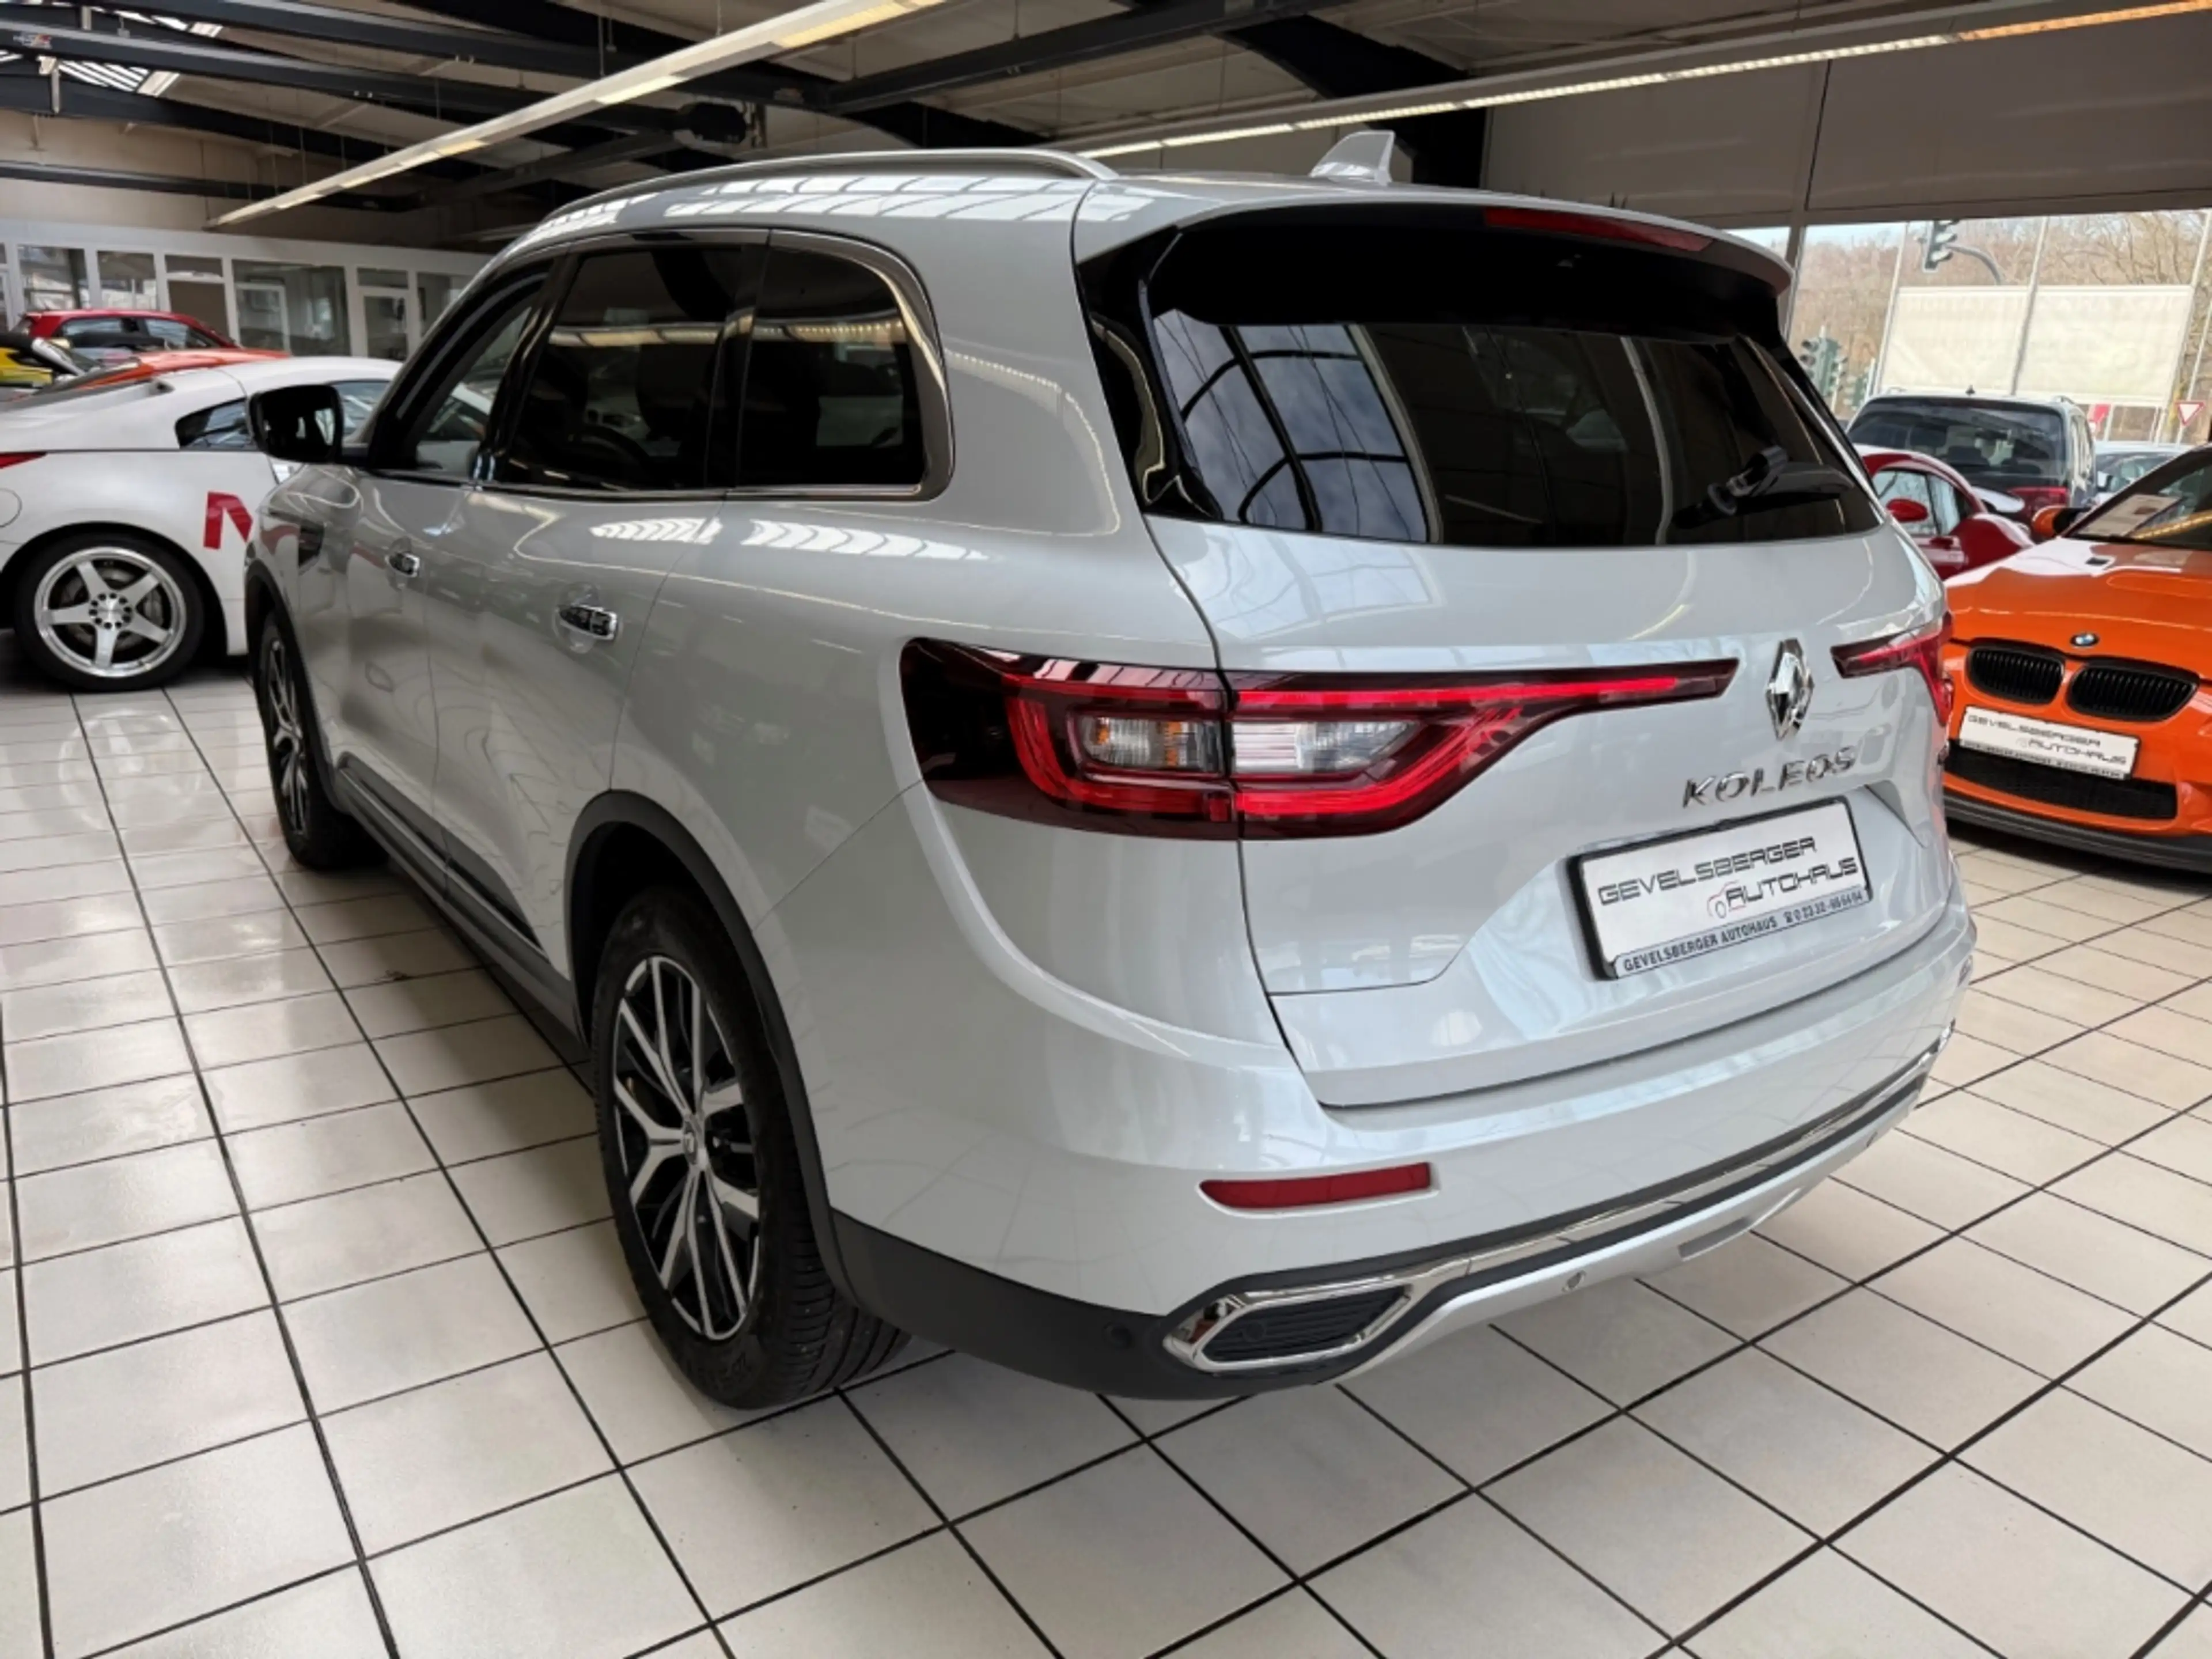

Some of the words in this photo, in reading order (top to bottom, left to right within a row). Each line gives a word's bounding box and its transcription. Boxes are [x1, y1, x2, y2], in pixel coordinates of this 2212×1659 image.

[1683, 745, 1856, 808] KOLEOS
[2028, 738, 2127, 765] AUTOHAUS
[1597, 836, 1817, 906] GEVELSBERGER
[1726, 857, 1858, 907] AUTOHAUS
[1624, 934, 1719, 972] GEVELSBERGER
[1721, 915, 1778, 944] AUTOHAUS
